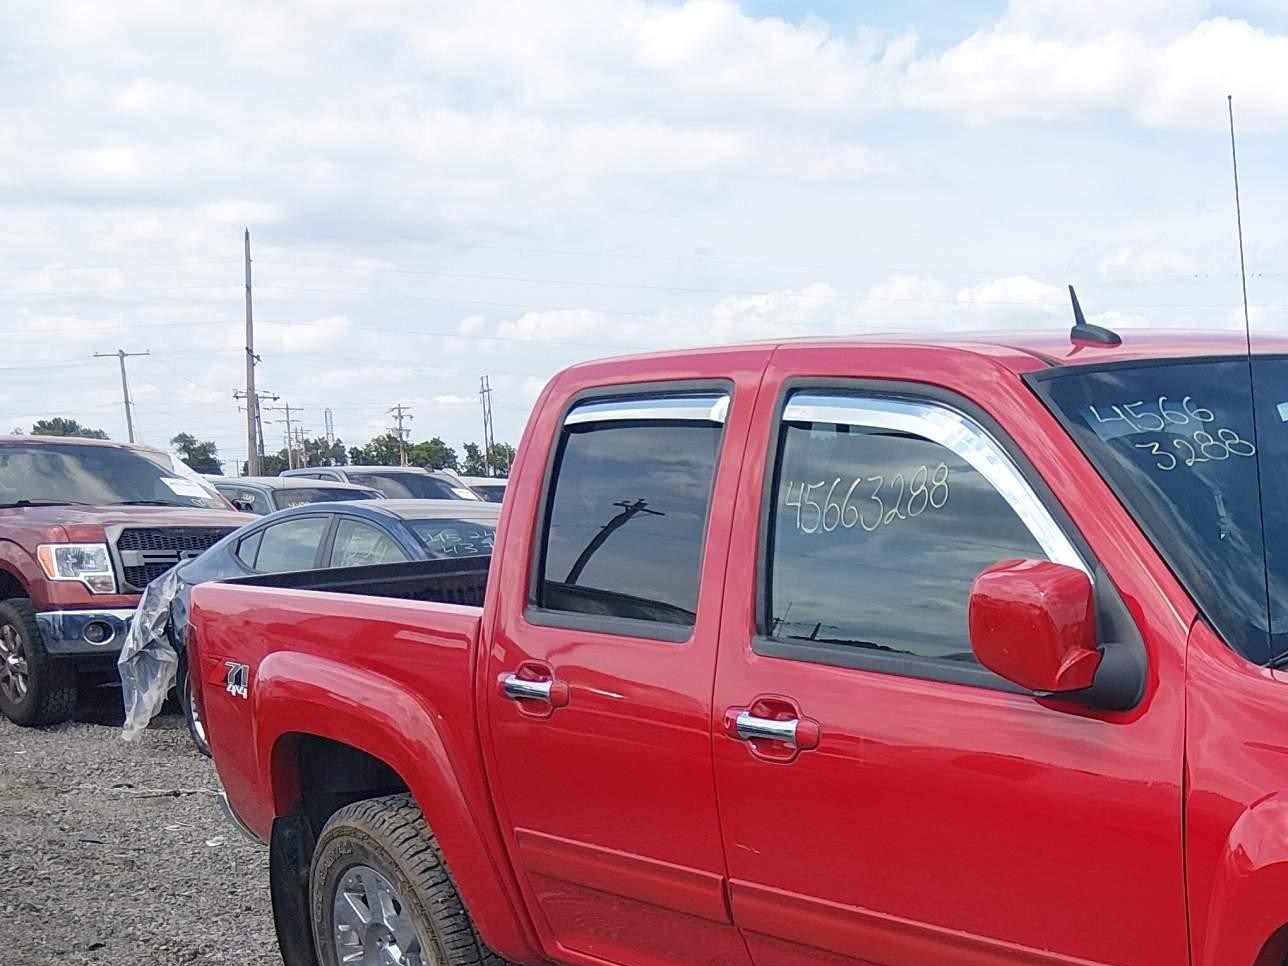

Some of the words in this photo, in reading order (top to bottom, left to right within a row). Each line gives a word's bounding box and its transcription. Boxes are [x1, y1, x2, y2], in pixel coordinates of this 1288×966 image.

[1089, 396, 1214, 433] 4566
[1134, 428, 1256, 471] 3288
[785, 462, 949, 534] 45663288
